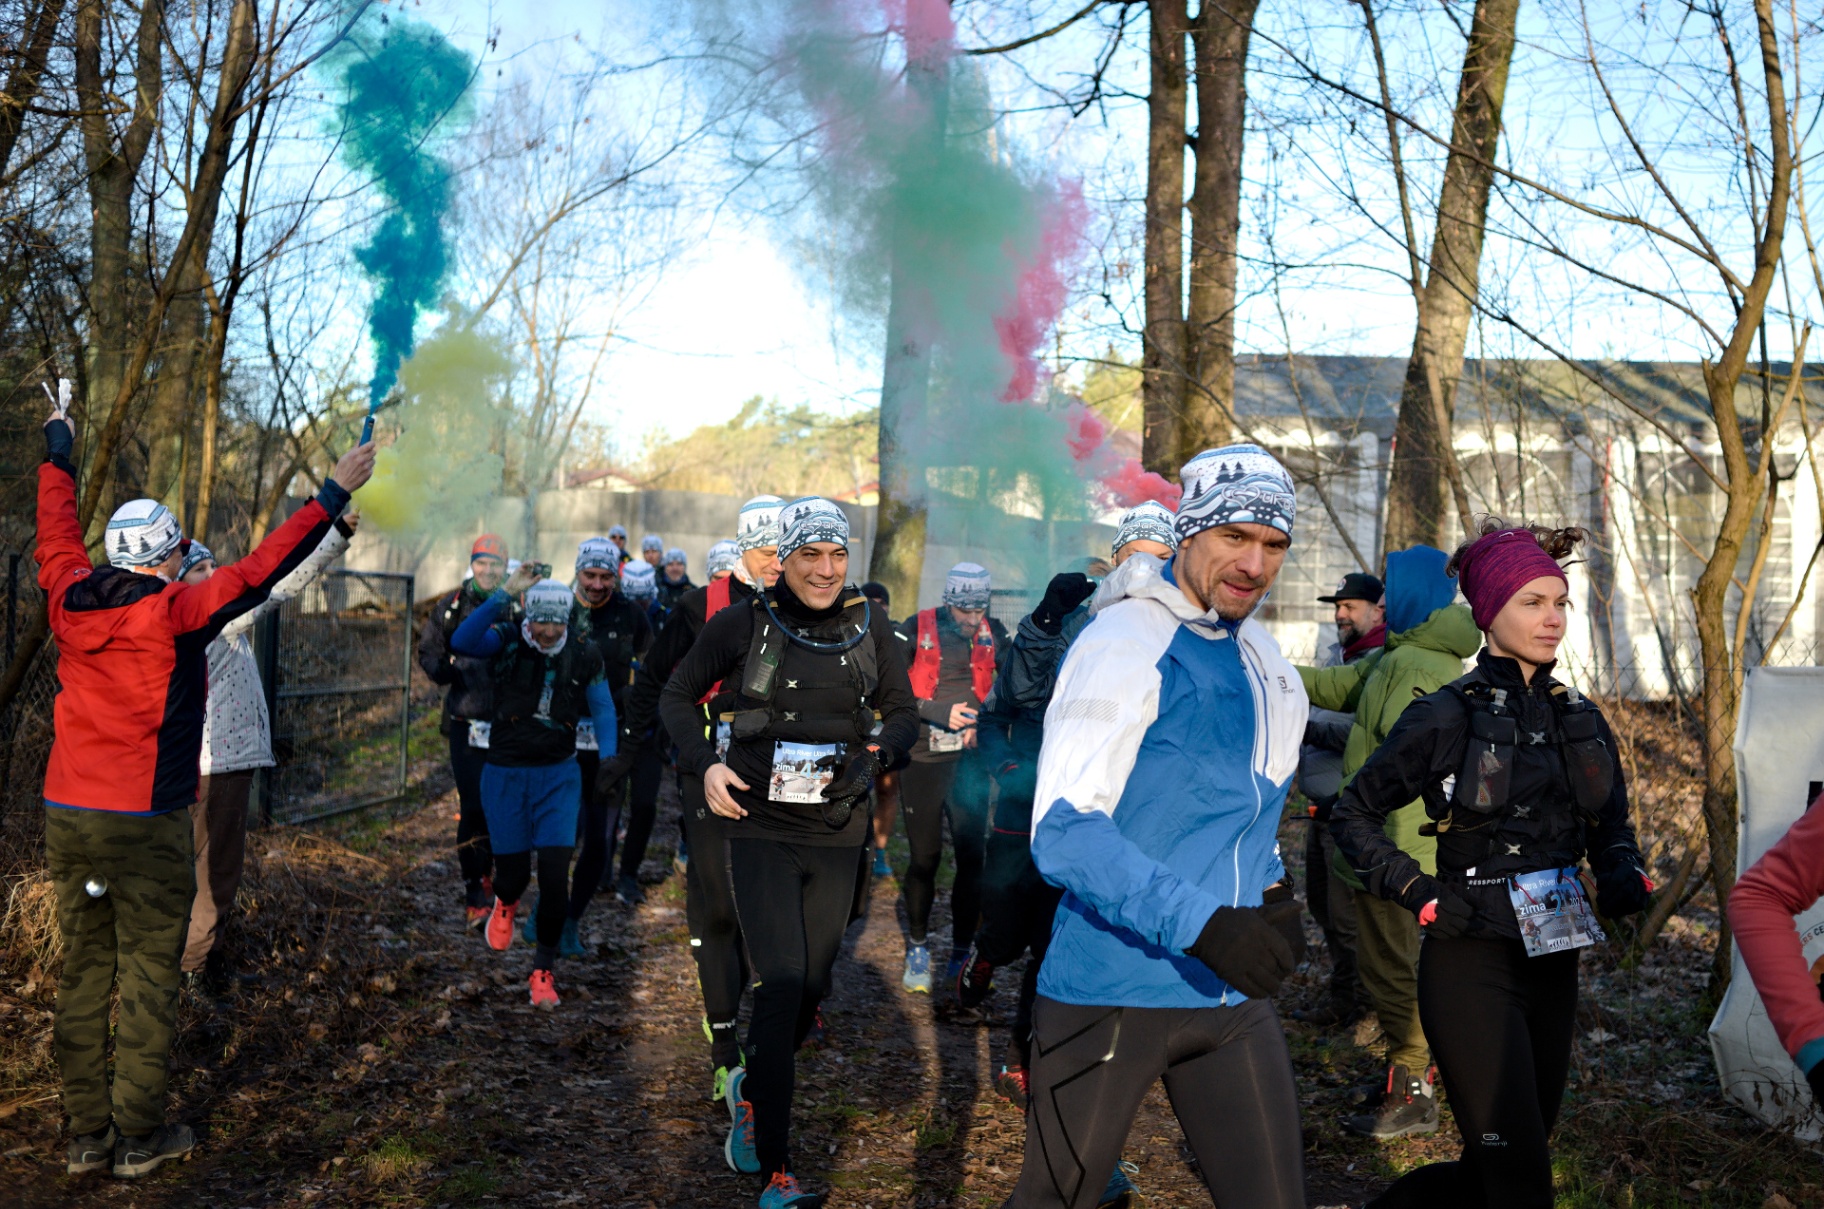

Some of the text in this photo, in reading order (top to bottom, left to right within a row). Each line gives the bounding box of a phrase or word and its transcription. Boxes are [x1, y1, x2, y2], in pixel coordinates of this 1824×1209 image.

[775, 763, 796, 772] zima
[1467, 877, 1506, 886] RESSPORT
[1519, 902, 1547, 916] zima
